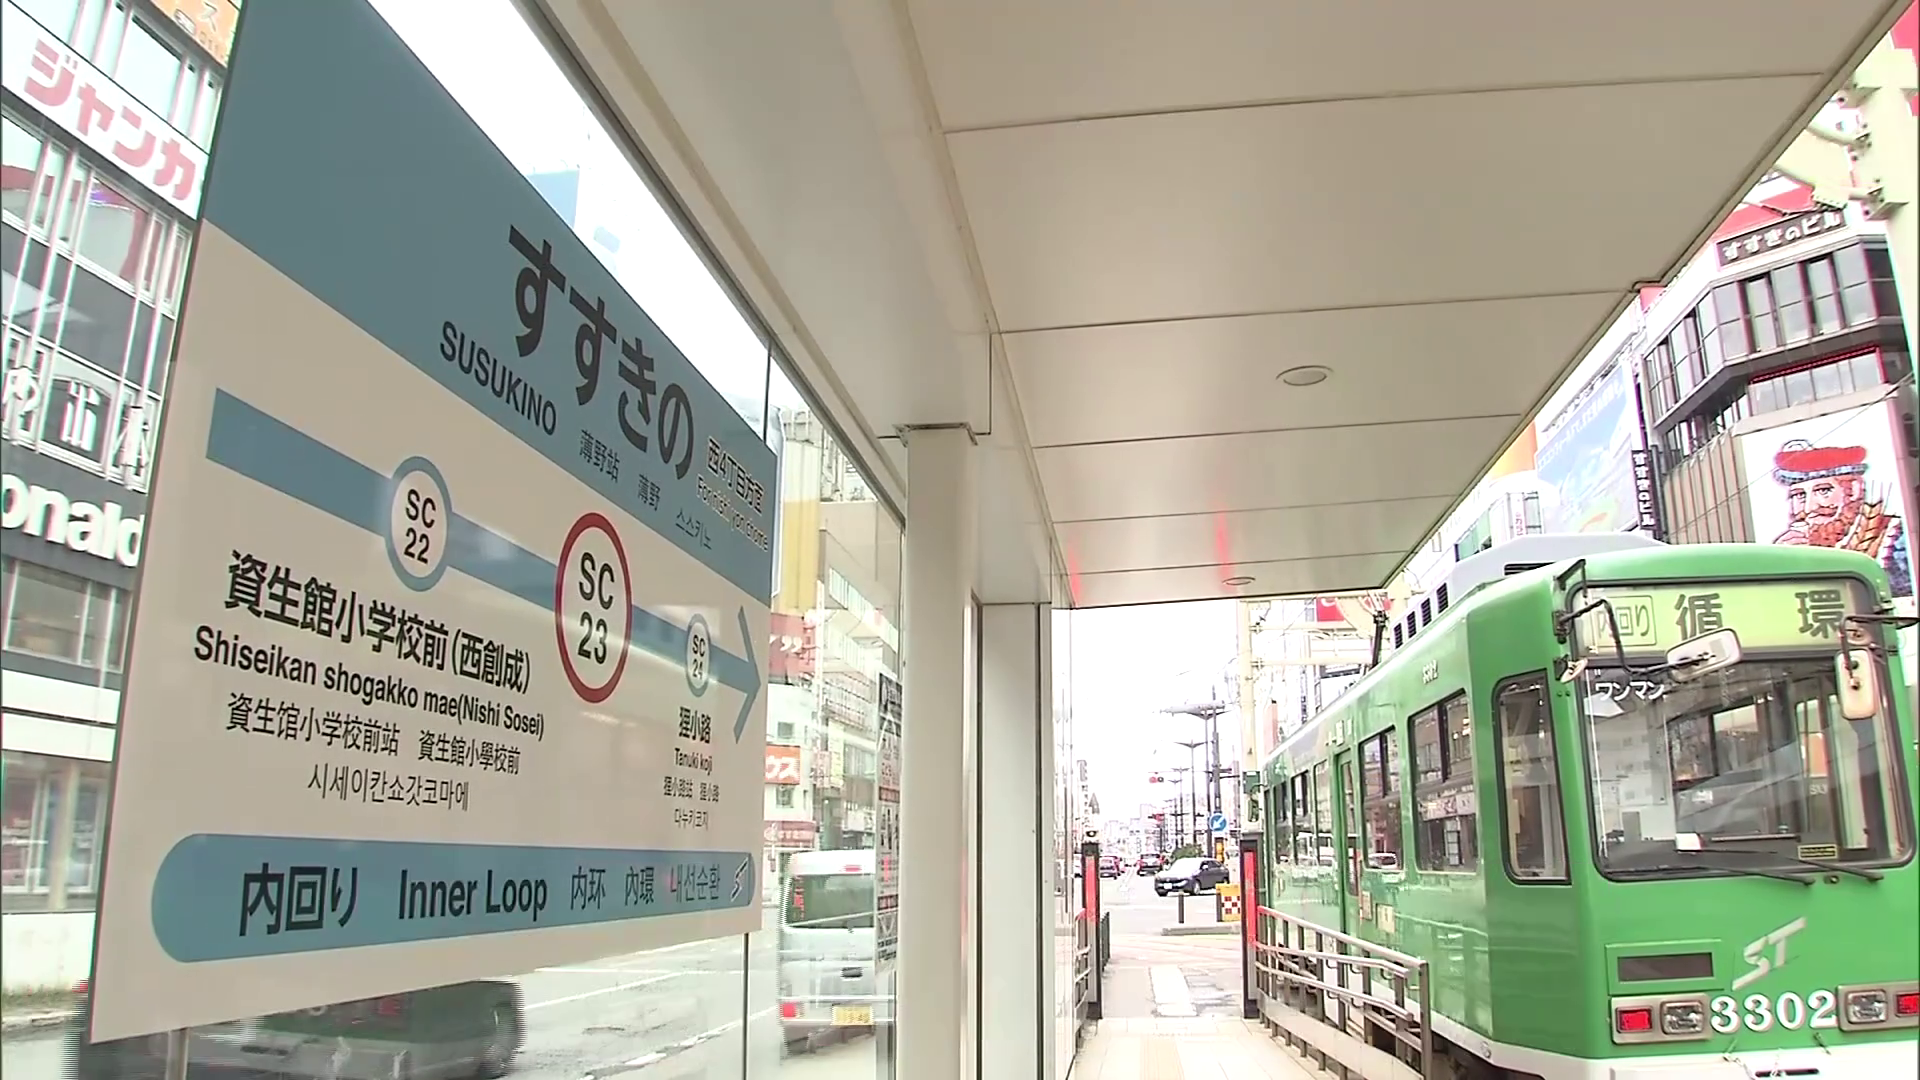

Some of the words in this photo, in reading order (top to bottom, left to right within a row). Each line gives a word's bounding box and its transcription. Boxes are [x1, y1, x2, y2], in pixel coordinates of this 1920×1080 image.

[24, 38, 197, 202] ジャンカ
[508, 224, 695, 481] すすきの
[439, 320, 558, 437] SUSUKINO
[405, 488, 437, 529] SC
[403, 527, 431, 564] 22
[579, 551, 616, 611] SC
[577, 611, 609, 665] 23
[692, 633, 706, 659] SC
[193, 624, 318, 686] Shiseikan
[323, 661, 419, 710] shogakko
[423, 690, 501, 727] mae(Nishi
[502, 704, 545, 742] Sosei)
[692, 657, 705, 682] 24
[1595, 681, 1665, 701] ワンマン
[674, 747, 700, 769] Tanuki
[699, 753, 713, 777] koji
[238, 862, 360, 937] 内回り
[399, 869, 478, 919] Inner
[485, 868, 548, 921] Loop
[570, 865, 606, 911] 内环
[669, 863, 721, 904] 내선순환
[1731, 916, 1807, 990] ST
[1710, 989, 1838, 1034] 3302
